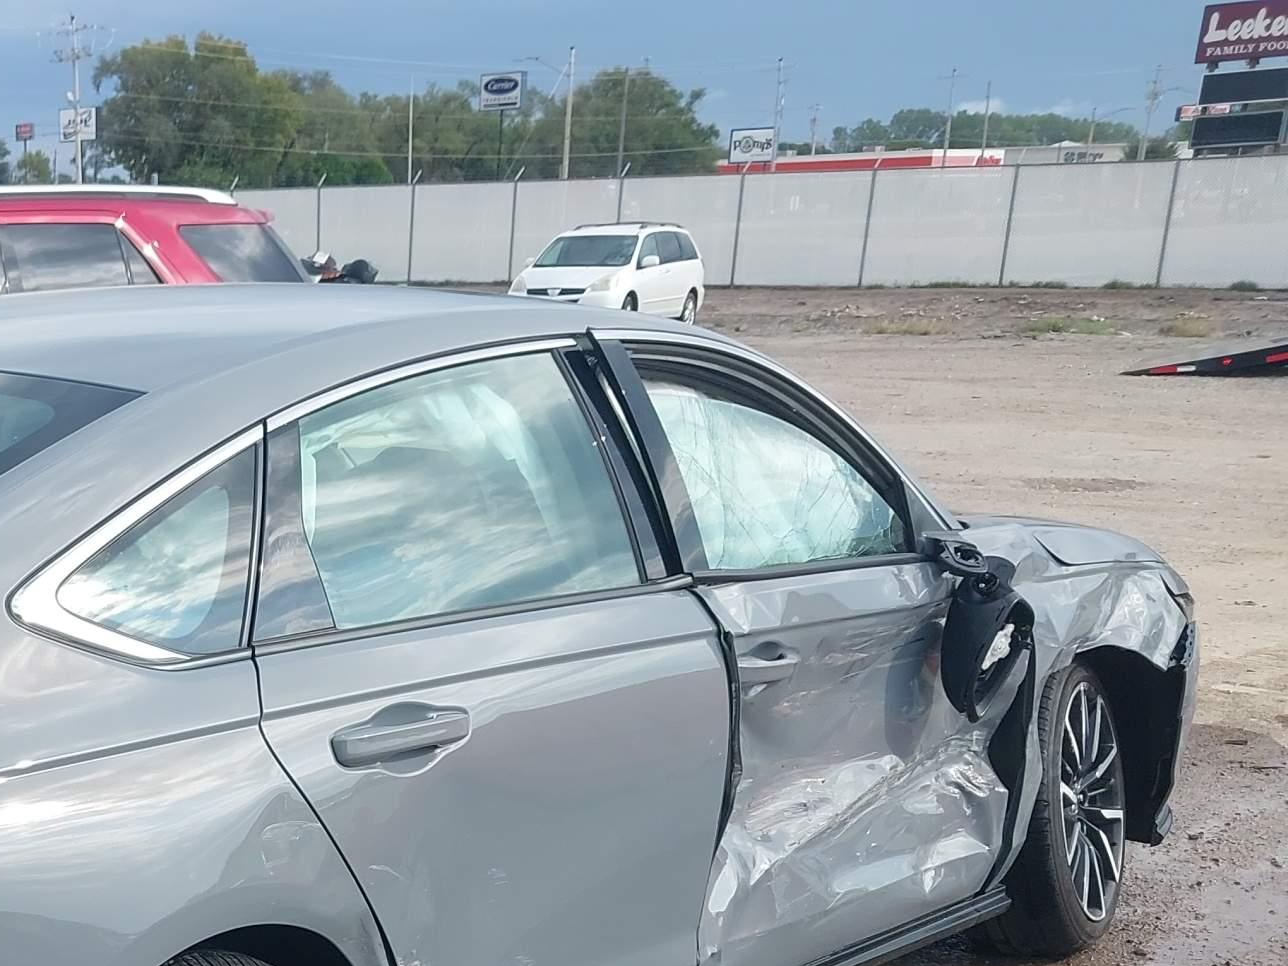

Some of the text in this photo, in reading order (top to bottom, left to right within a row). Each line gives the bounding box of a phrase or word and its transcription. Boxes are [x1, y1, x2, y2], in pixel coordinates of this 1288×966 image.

[1203, 7, 1288, 43] Leeke
[1206, 43, 1256, 56] FAMILY
[487, 80, 516, 91] Carrier
